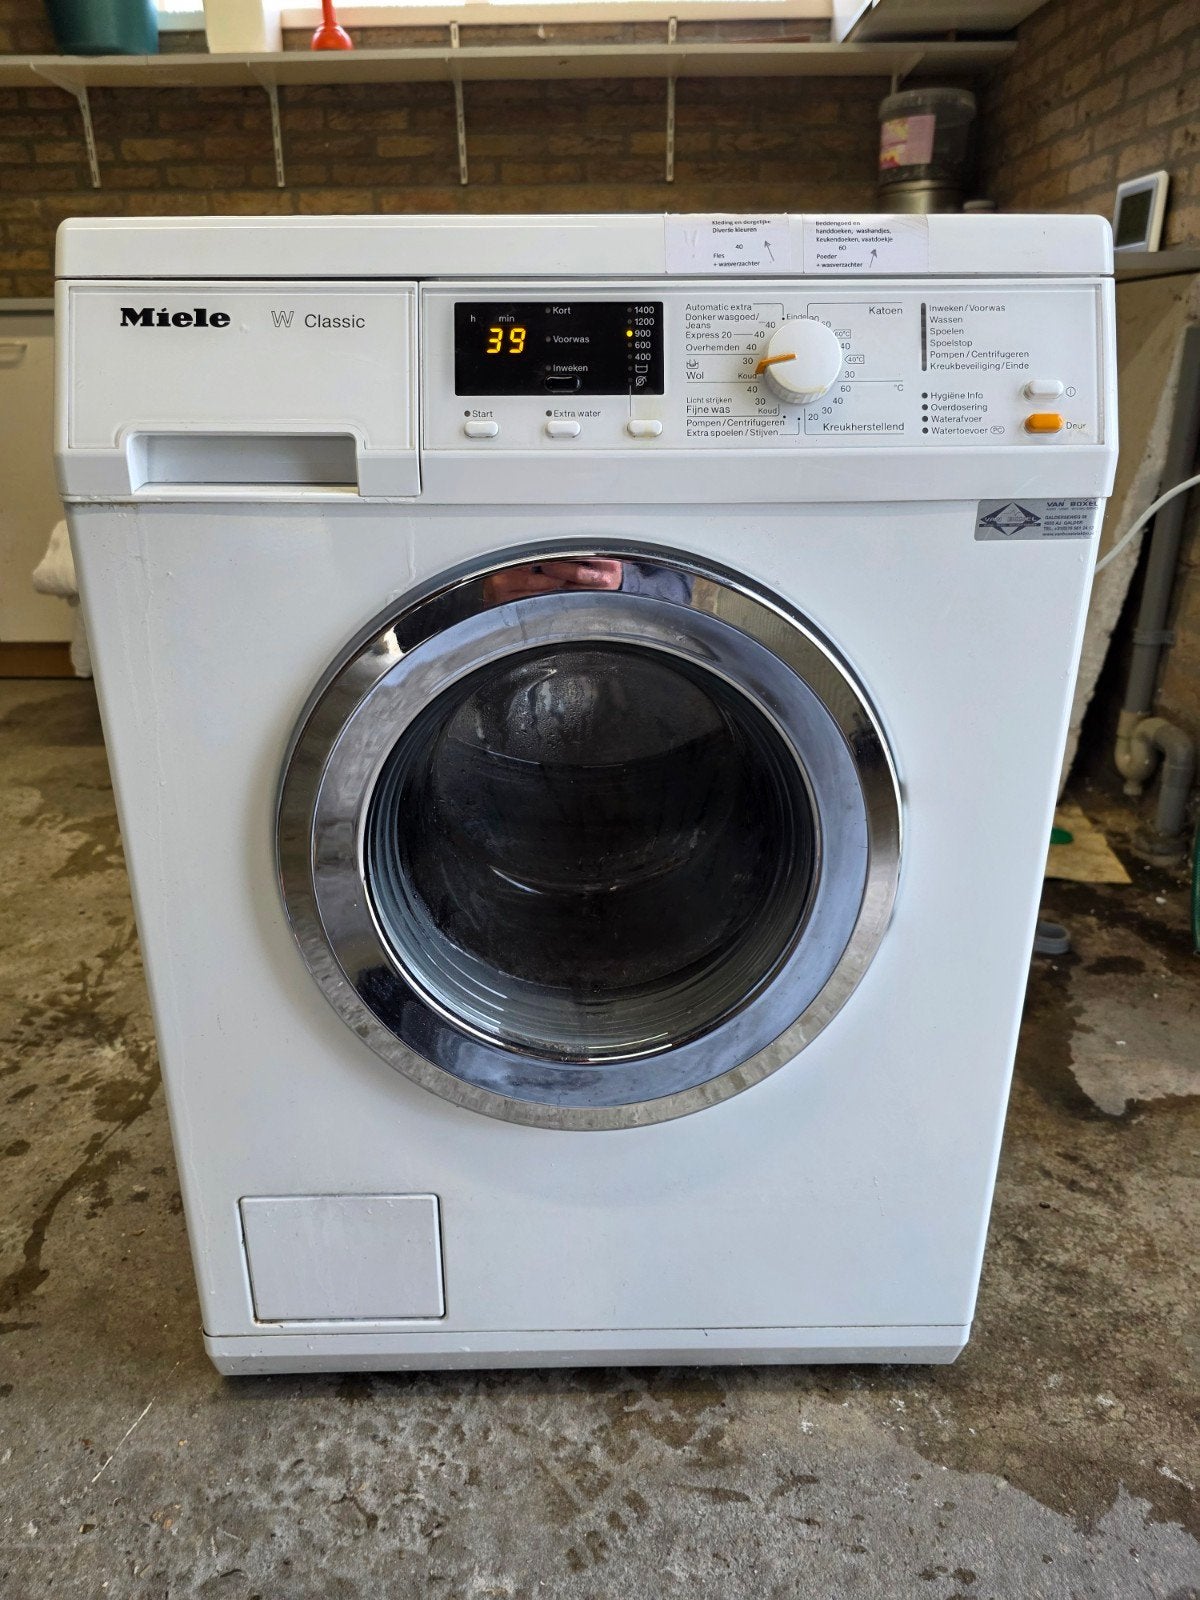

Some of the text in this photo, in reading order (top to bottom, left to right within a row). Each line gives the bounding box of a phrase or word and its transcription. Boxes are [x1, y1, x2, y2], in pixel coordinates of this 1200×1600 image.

[869, 306, 903, 315] Katoen
[120, 308, 230, 328] Miele
[271, 310, 366, 328] W Classic
[718, 313, 760, 322] wasgoed/
[486, 327, 526, 354] 39
[930, 340, 973, 348] Spoelstop
[931, 392, 966, 401] Hygiëne
[686, 406, 709, 415] Fijne
[931, 404, 988, 412] Overdosering
[823, 422, 904, 431] Kreukherstellend
